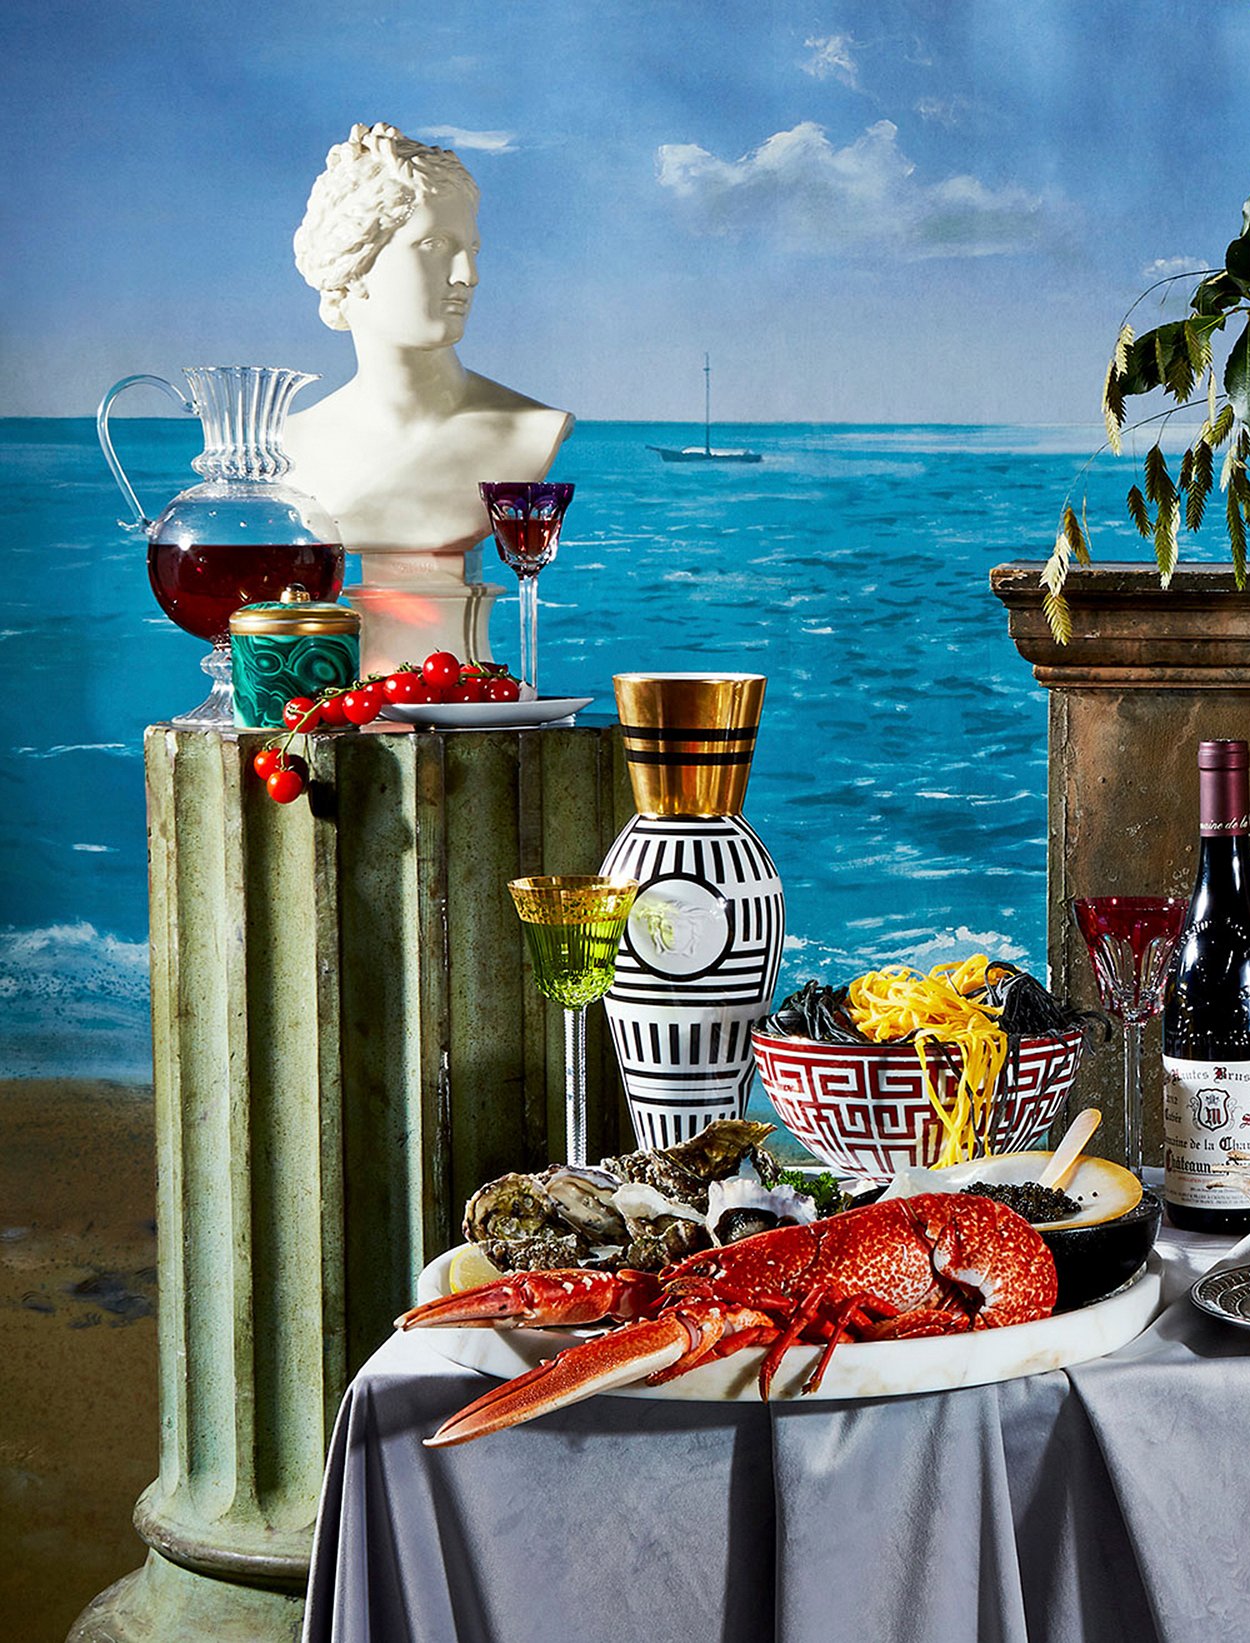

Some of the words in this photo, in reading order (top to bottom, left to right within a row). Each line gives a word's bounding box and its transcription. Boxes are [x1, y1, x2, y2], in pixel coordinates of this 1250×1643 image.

[1225, 817, 1238, 829] de
[1190, 1138, 1201, 1149] de
[1204, 1139, 1215, 1151] la
